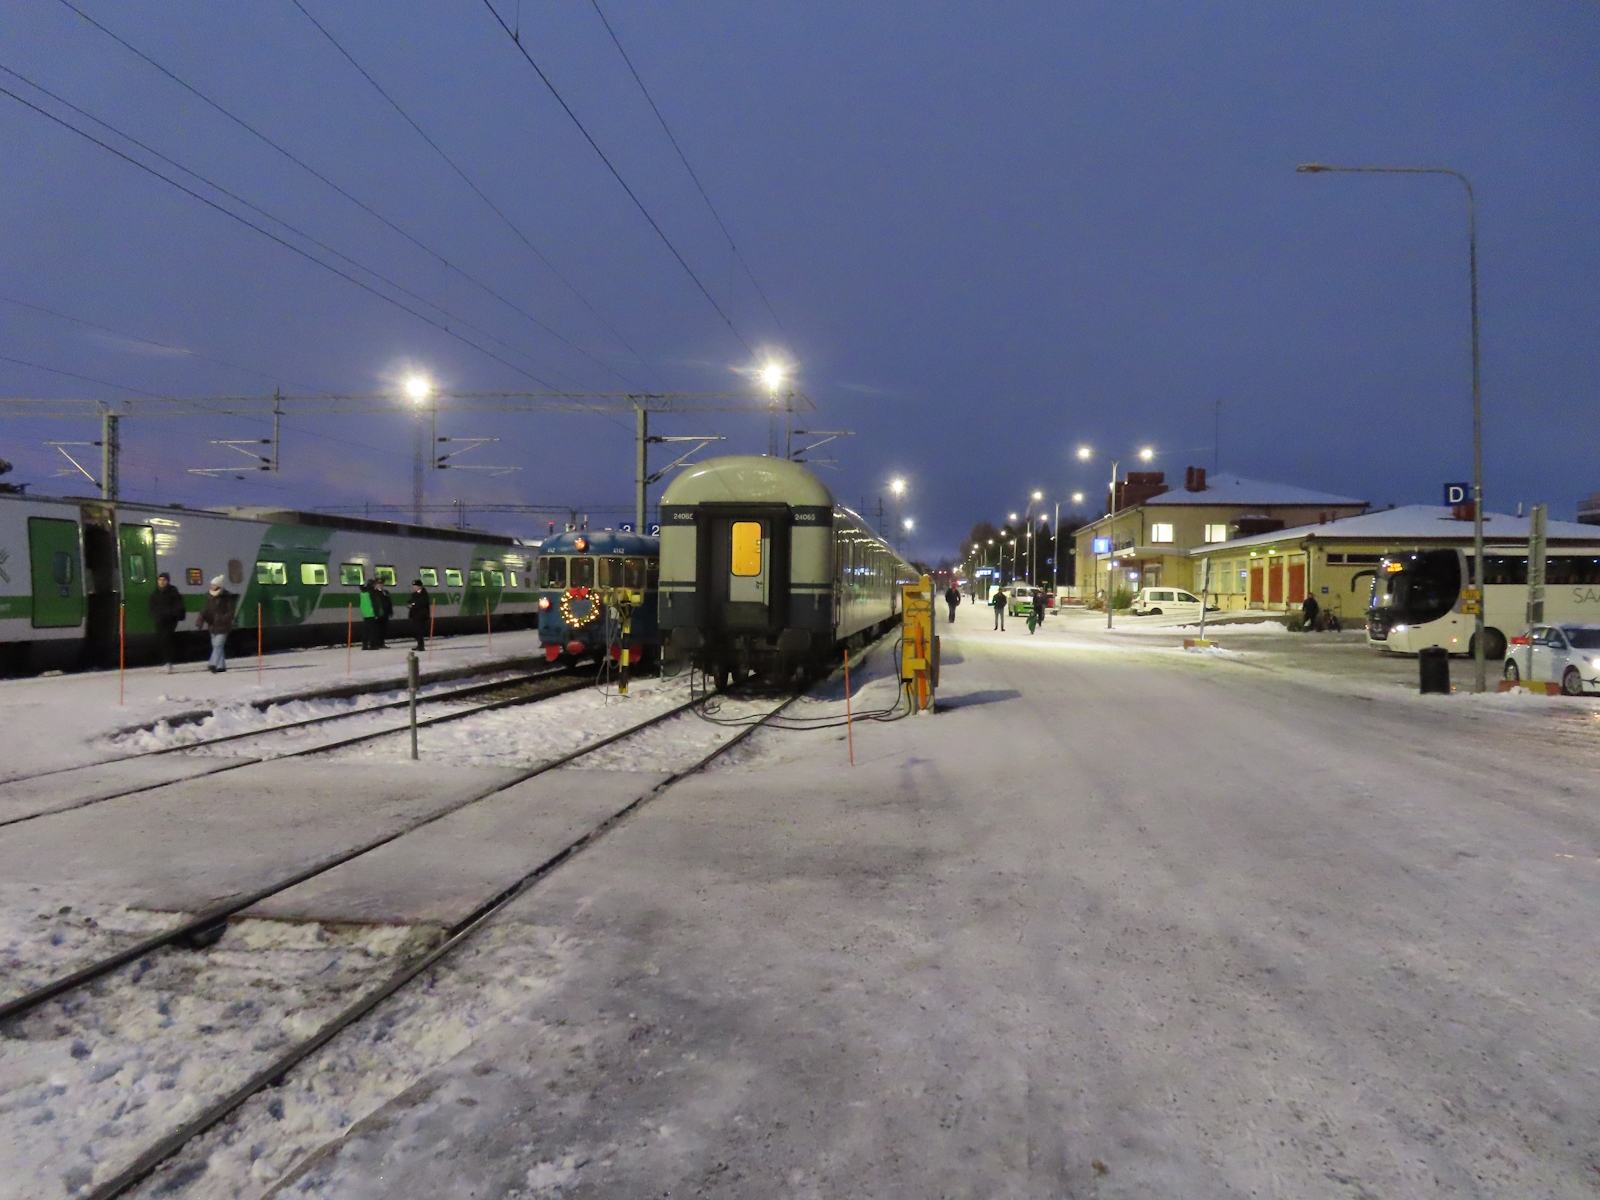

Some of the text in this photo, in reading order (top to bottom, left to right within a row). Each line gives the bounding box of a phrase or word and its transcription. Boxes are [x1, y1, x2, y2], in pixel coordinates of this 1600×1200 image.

[1449, 486, 1464, 503] D
[795, 513, 816, 521] 24065
[651, 525, 660, 536] 2
[1098, 540, 1105, 552] 1
